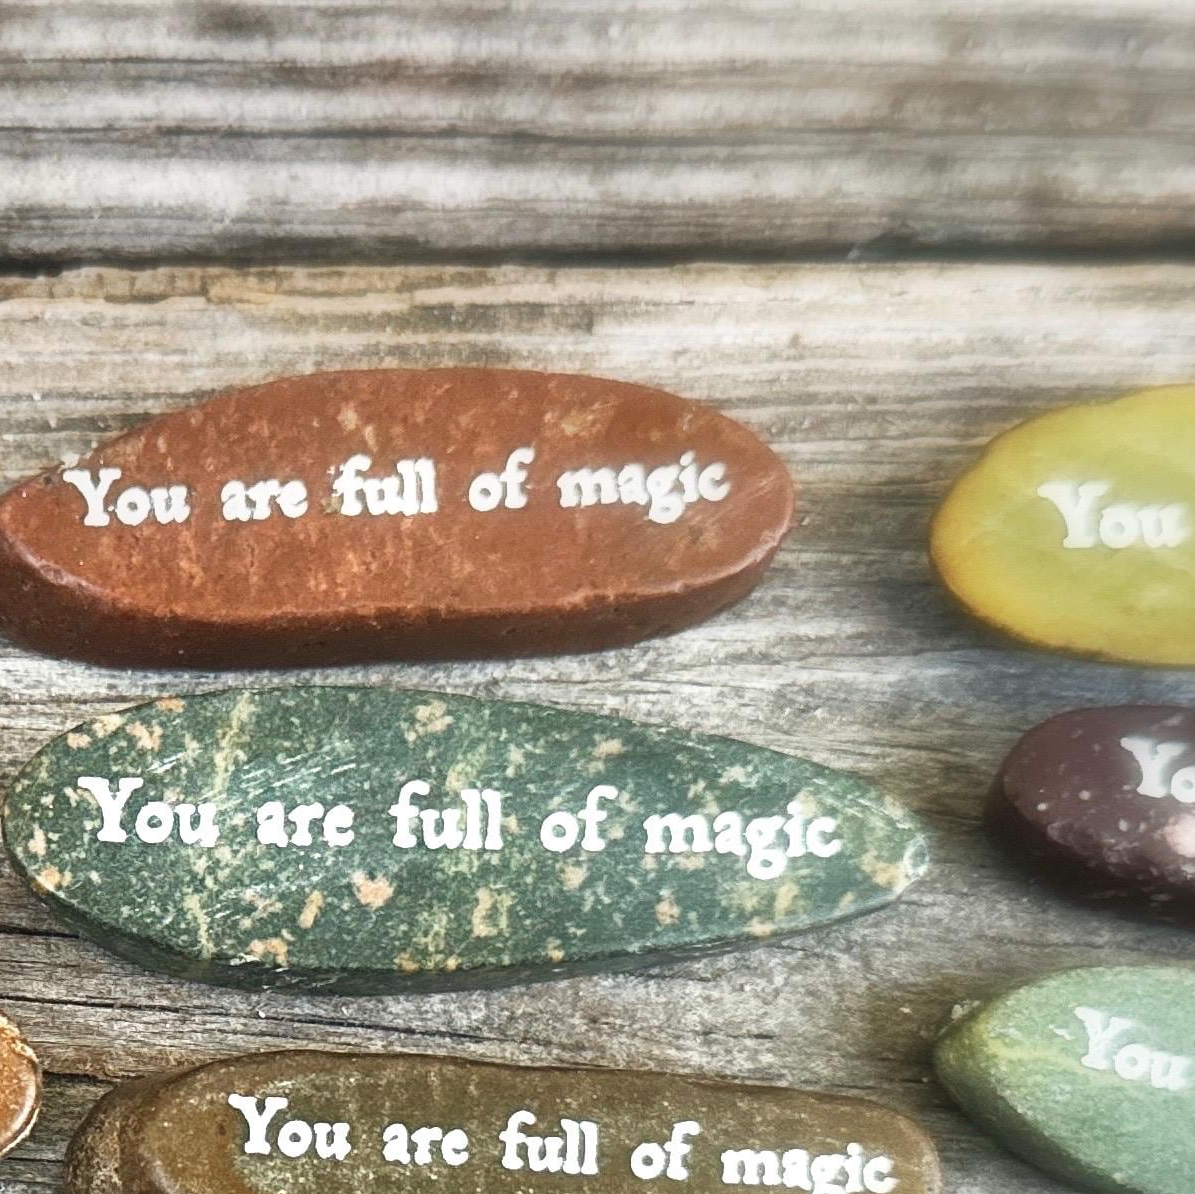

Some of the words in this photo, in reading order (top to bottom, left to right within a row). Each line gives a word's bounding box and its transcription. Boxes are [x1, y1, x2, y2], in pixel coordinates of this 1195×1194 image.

[61, 468, 189, 526] You
[220, 476, 307, 522] are
[333, 453, 435, 516] full
[469, 448, 535, 510] of
[557, 450, 728, 523] magic
[1037, 481, 1188, 549] You
[77, 776, 223, 847] You
[253, 797, 354, 849] are
[391, 782, 503, 853] full
[540, 785, 619, 853] of
[643, 800, 843, 879] magic
[1074, 1007, 1192, 1091] You
[226, 1094, 352, 1160] You
[382, 1120, 468, 1166] are
[500, 1111, 599, 1175] full
[630, 1120, 698, 1180] of
